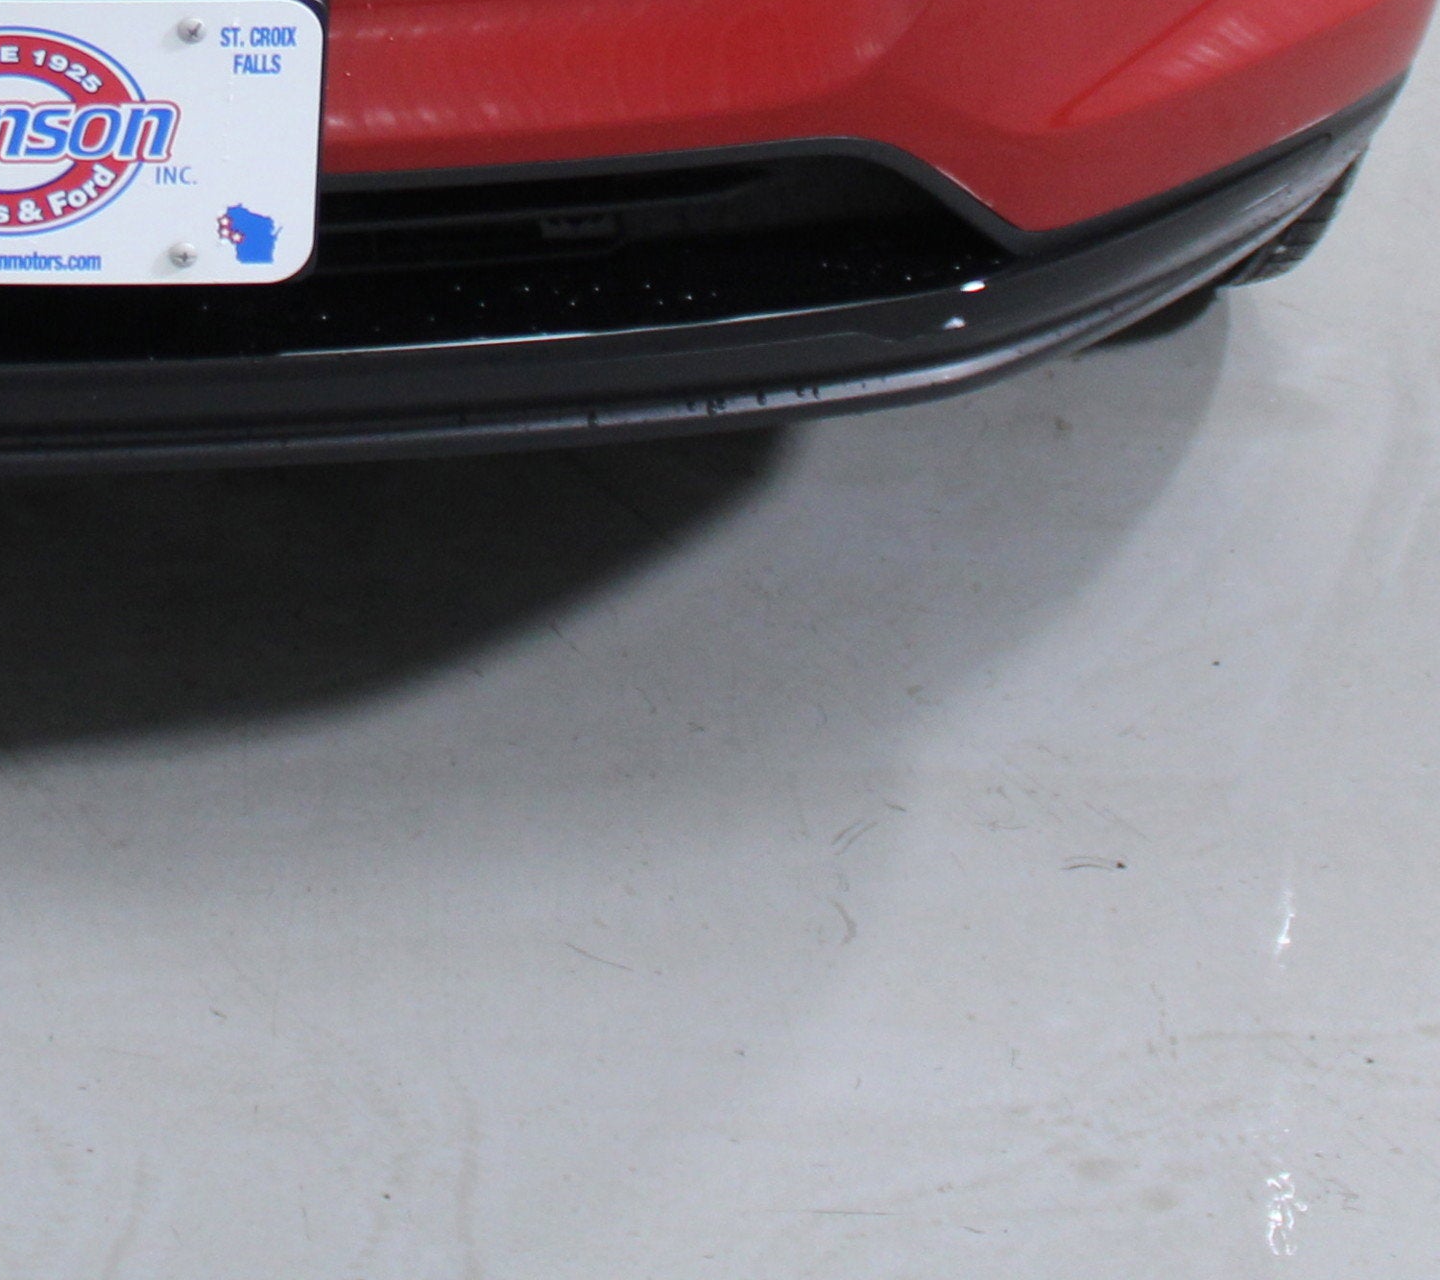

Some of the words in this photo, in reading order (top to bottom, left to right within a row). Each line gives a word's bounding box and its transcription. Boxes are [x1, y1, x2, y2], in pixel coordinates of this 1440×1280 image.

[220, 26, 244, 47] ST.
[250, 26, 297, 47] CROIX
[32, 49, 104, 94] 1925
[233, 54, 281, 74] FALLS
[154, 166, 198, 185] INC.
[18, 199, 43, 223] &
[47, 162, 118, 218] Ford
